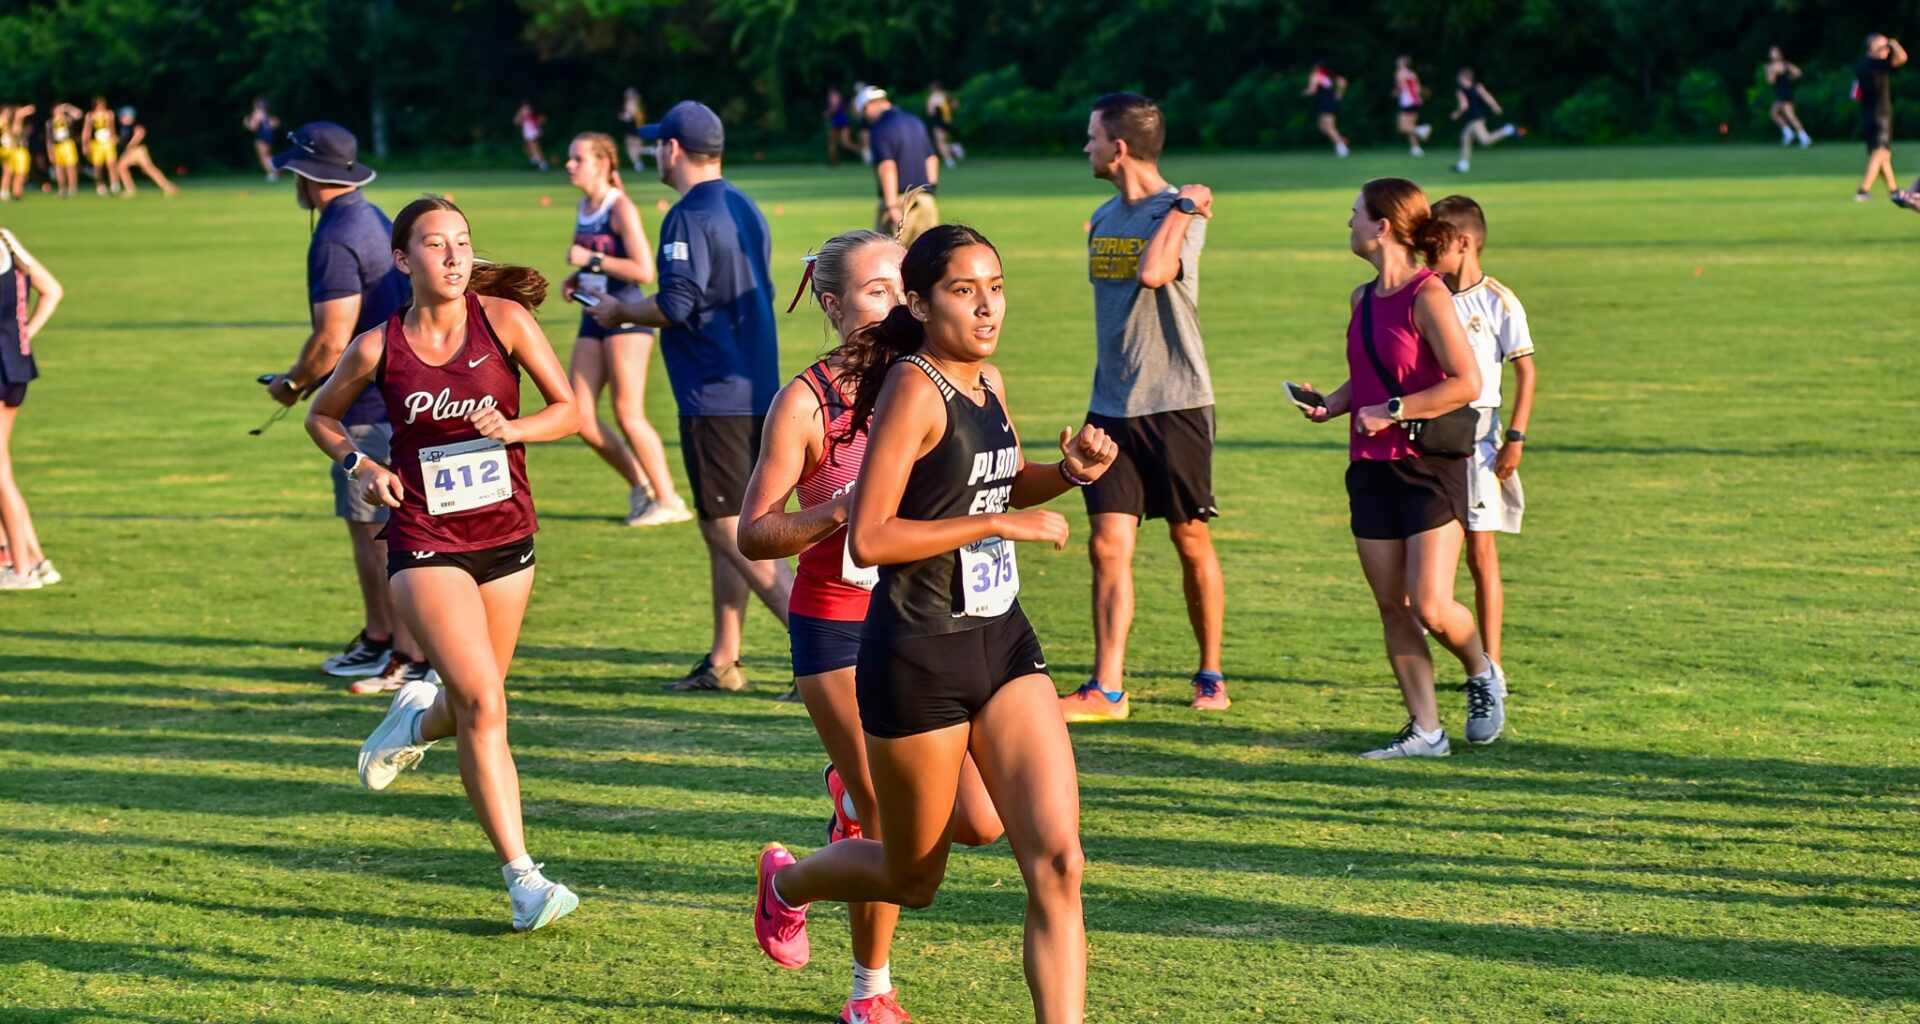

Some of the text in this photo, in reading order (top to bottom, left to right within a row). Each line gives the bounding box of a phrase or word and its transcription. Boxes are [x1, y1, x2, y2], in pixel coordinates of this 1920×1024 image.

[404, 388, 497, 424] Plano
[434, 460, 500, 491] 412
[972, 552, 1012, 592] 375
